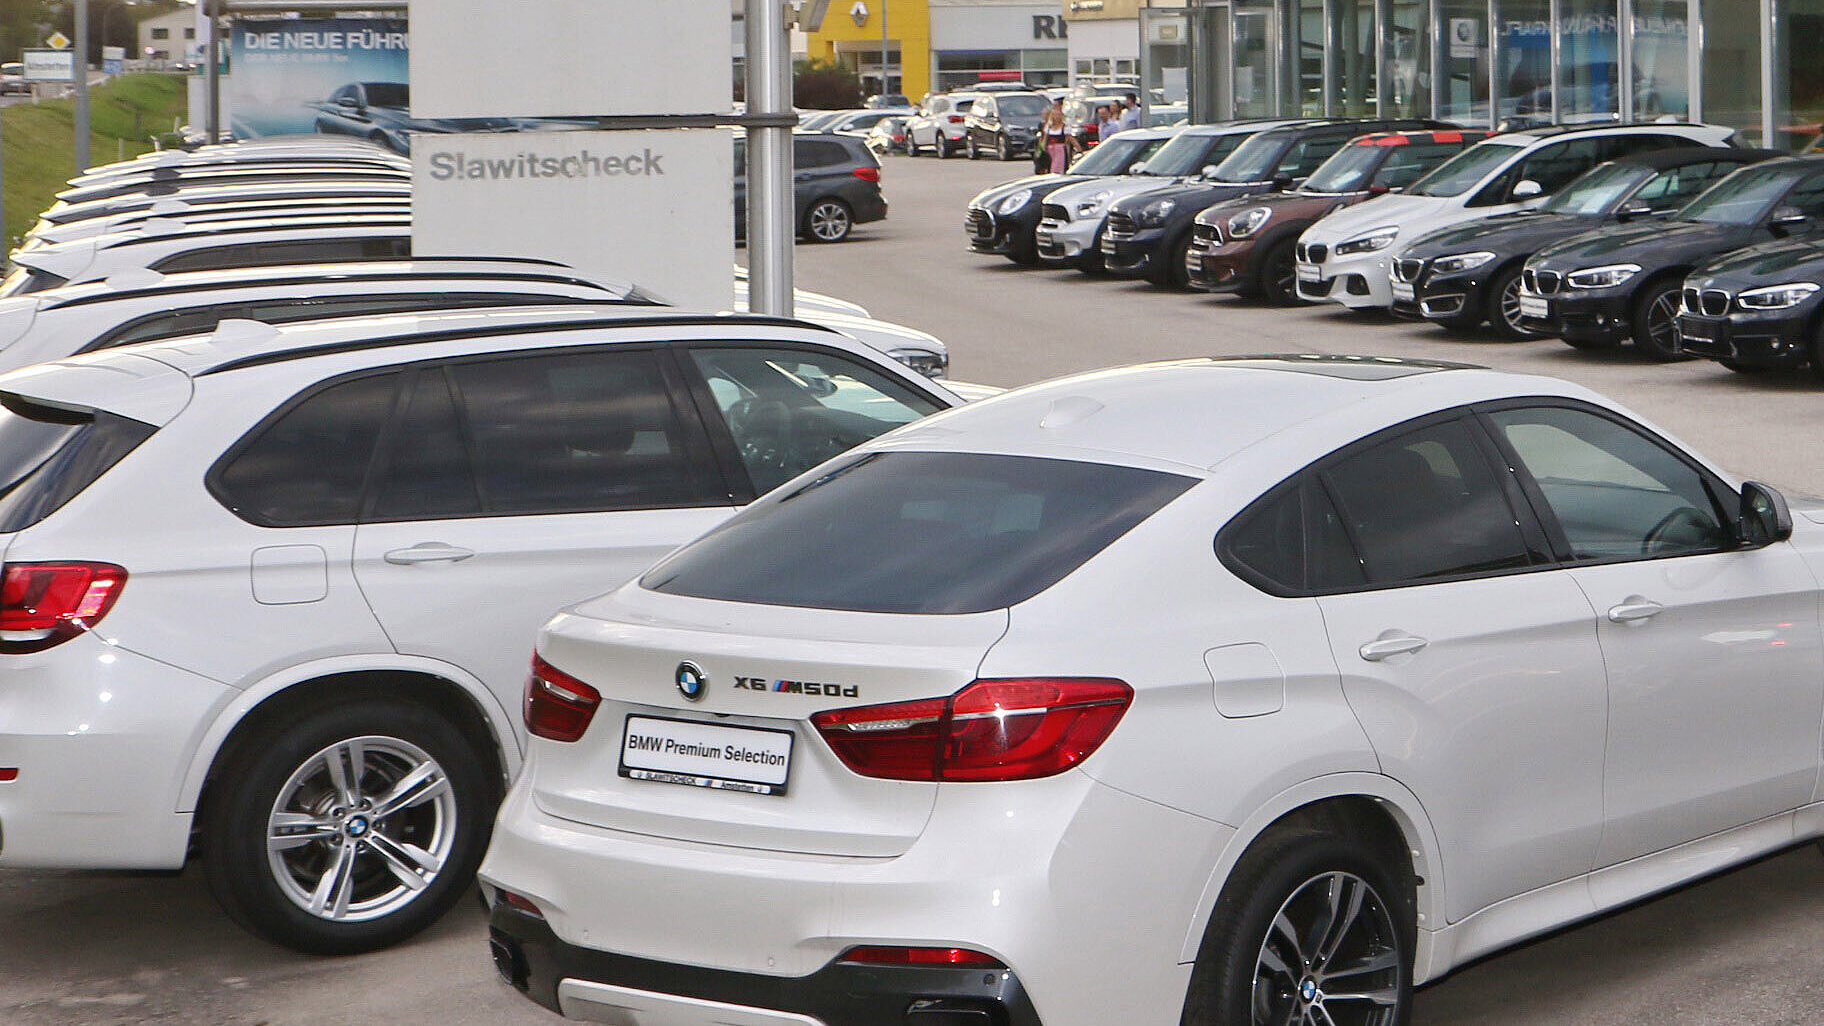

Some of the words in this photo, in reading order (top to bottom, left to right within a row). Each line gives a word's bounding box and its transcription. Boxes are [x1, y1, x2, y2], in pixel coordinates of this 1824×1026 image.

[244, 32, 280, 50] DIE
[284, 32, 343, 50] NEUE
[347, 28, 408, 50] FÜHR
[430, 148, 664, 180] Slawitscheck
[734, 676, 766, 691] X6
[628, 734, 663, 752] BMW
[665, 739, 720, 759] Premium
[725, 745, 785, 766] Selection
